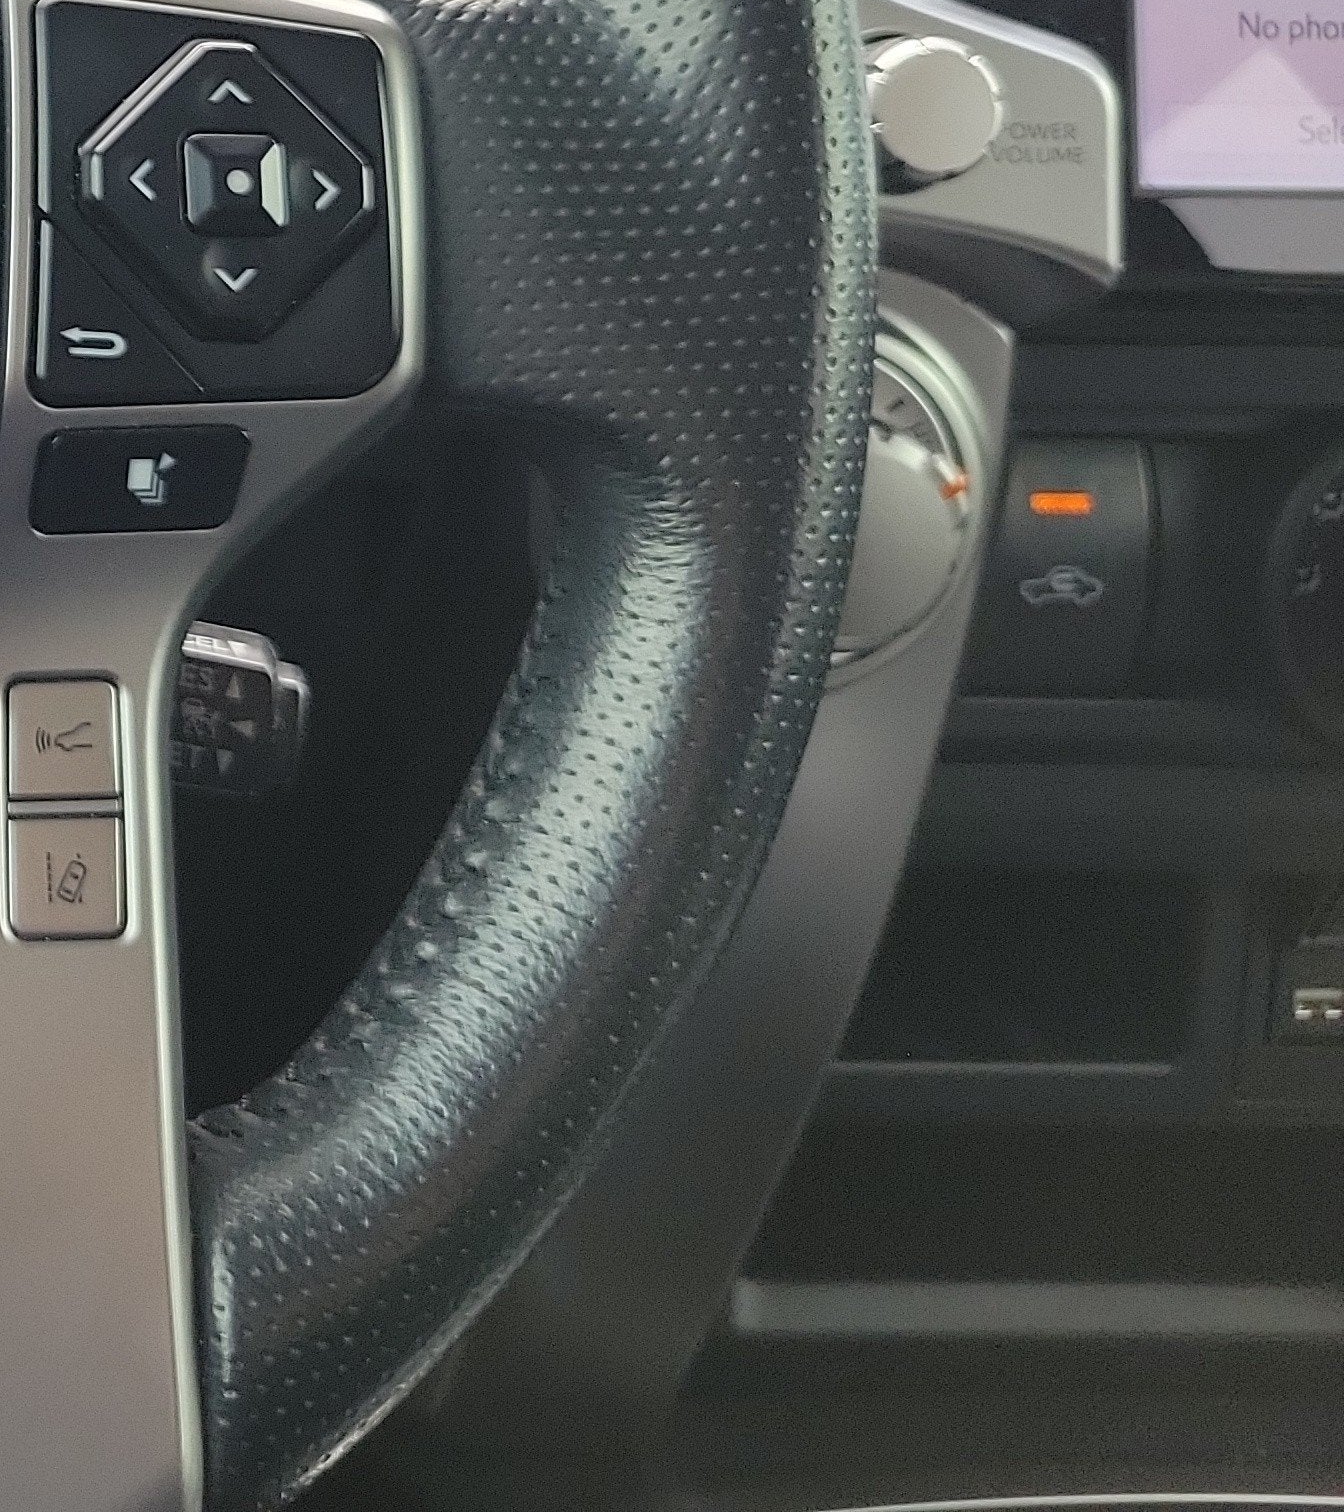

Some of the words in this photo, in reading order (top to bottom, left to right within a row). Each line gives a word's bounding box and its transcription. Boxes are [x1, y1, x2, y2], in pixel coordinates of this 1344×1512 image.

[1238, 12, 1279, 39] No
[1289, 13, 1344, 48] pho
[1001, 121, 1076, 141] OWER
